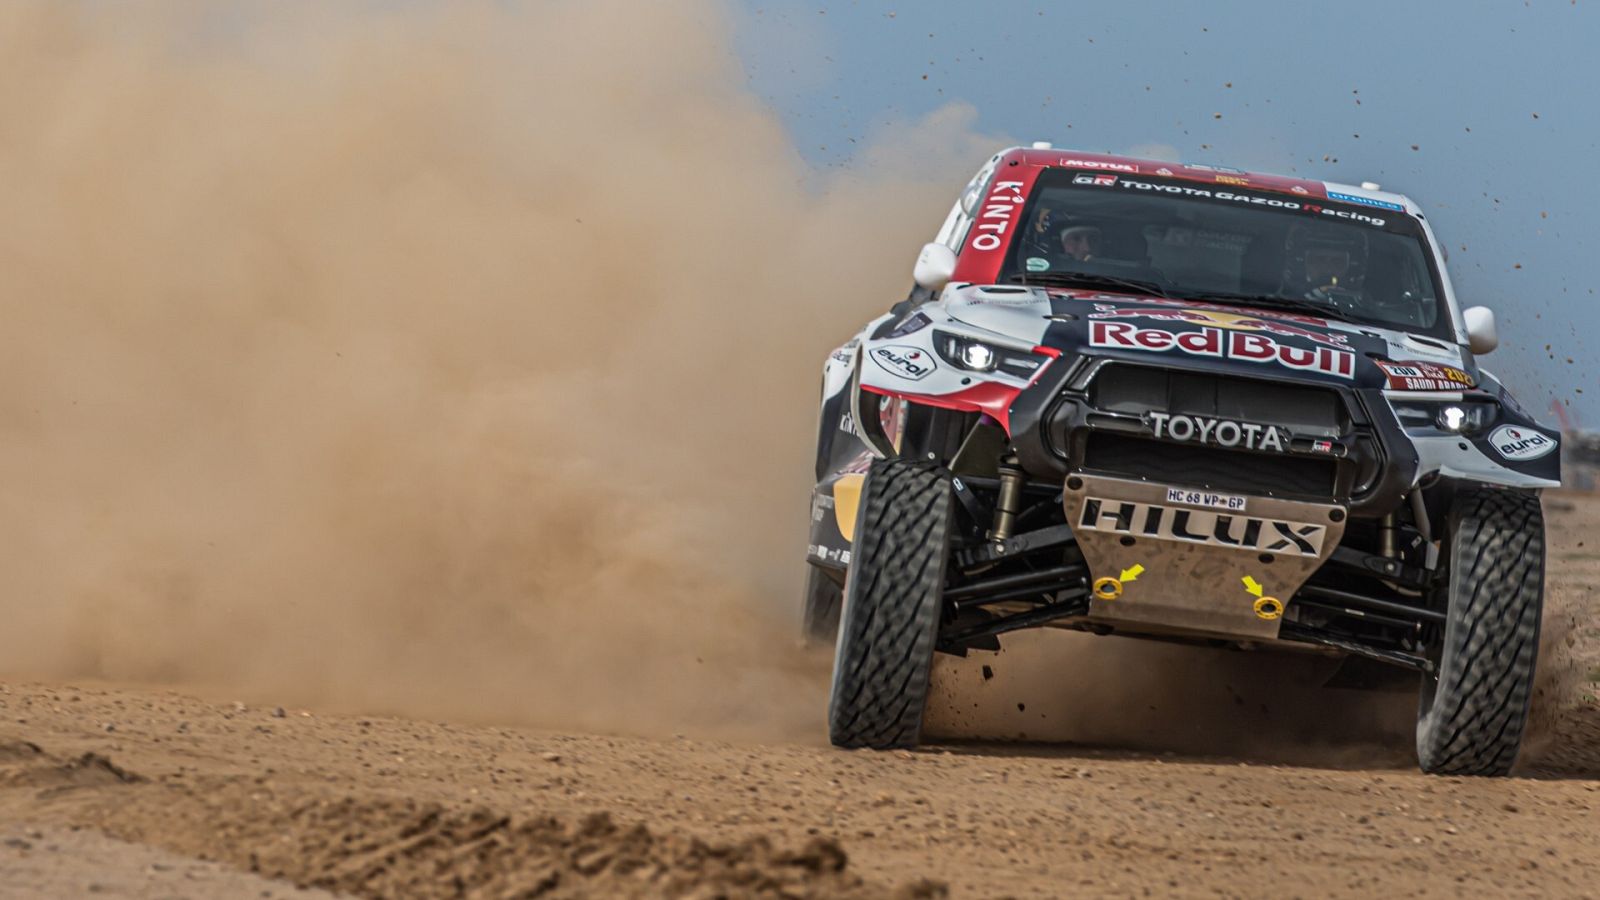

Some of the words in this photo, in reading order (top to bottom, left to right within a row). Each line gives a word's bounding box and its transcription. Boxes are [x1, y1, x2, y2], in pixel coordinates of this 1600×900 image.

[1065, 160, 1135, 171] MOTUL
[1074, 176, 1116, 186] GR
[1120, 180, 1211, 198] TOYOTA
[1215, 192, 1300, 210] GAZOO
[1303, 204, 1386, 226] Racing
[878, 349, 928, 376] eurol
[1089, 320, 1223, 357] Red
[1228, 331, 1356, 379] Bull
[1406, 378, 1437, 391] SAUDI
[1150, 412, 1283, 451] TOYOTA
[1501, 434, 1547, 454] eurol
[1168, 490, 1184, 501] HC
[1186, 493, 1201, 503] 68
[1203, 494, 1219, 506] WP
[1228, 497, 1243, 509] GP
[1081, 499, 1320, 556] HILUX
